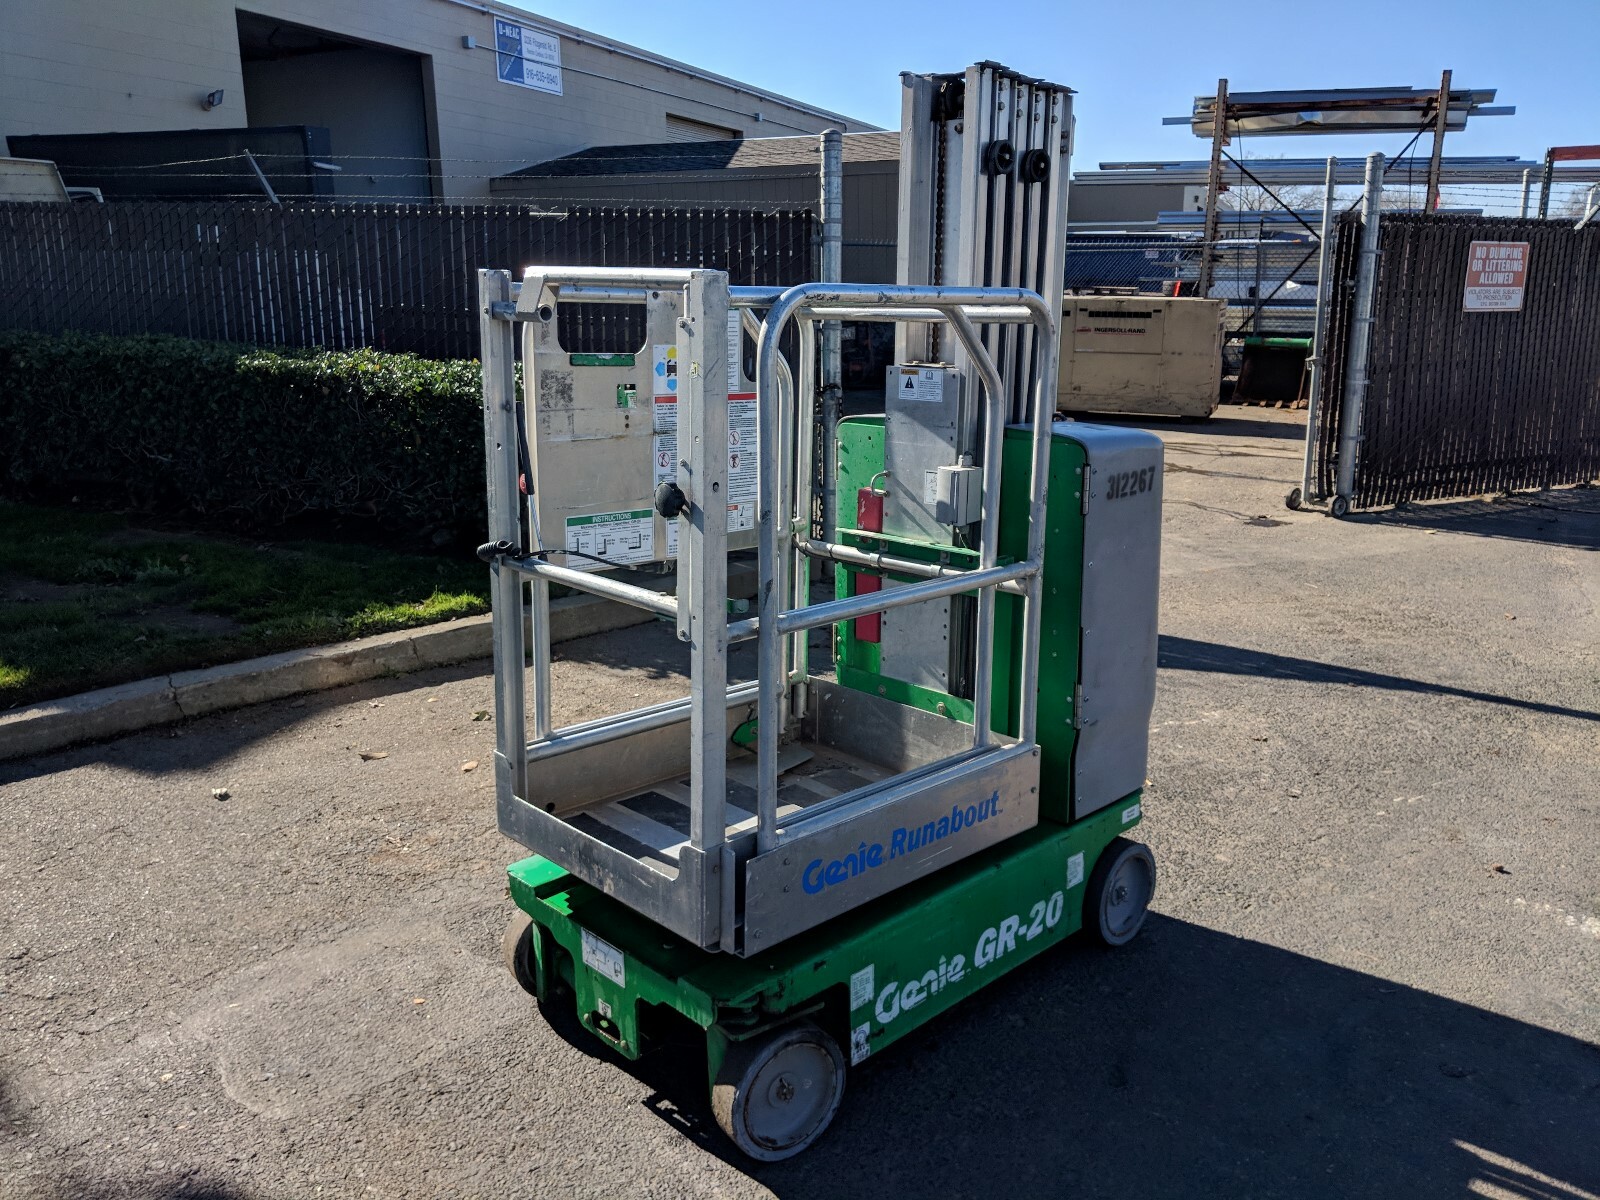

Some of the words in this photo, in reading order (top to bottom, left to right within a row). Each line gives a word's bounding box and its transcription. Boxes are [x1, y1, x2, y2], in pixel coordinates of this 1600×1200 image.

[1475, 246, 1487, 259] NO
[1489, 246, 1523, 259] DUMPING
[1471, 259, 1483, 272] OR
[1485, 259, 1524, 272] LITTERING
[1478, 272, 1514, 285] ALLOWED
[1106, 466, 1156, 501] 312267
[592, 512, 632, 523] INSTRUCTIONS
[802, 841, 884, 895] Genie
[890, 790, 1000, 860] Runabout
[875, 955, 966, 1024] Genie
[974, 890, 1064, 969] GR-20
